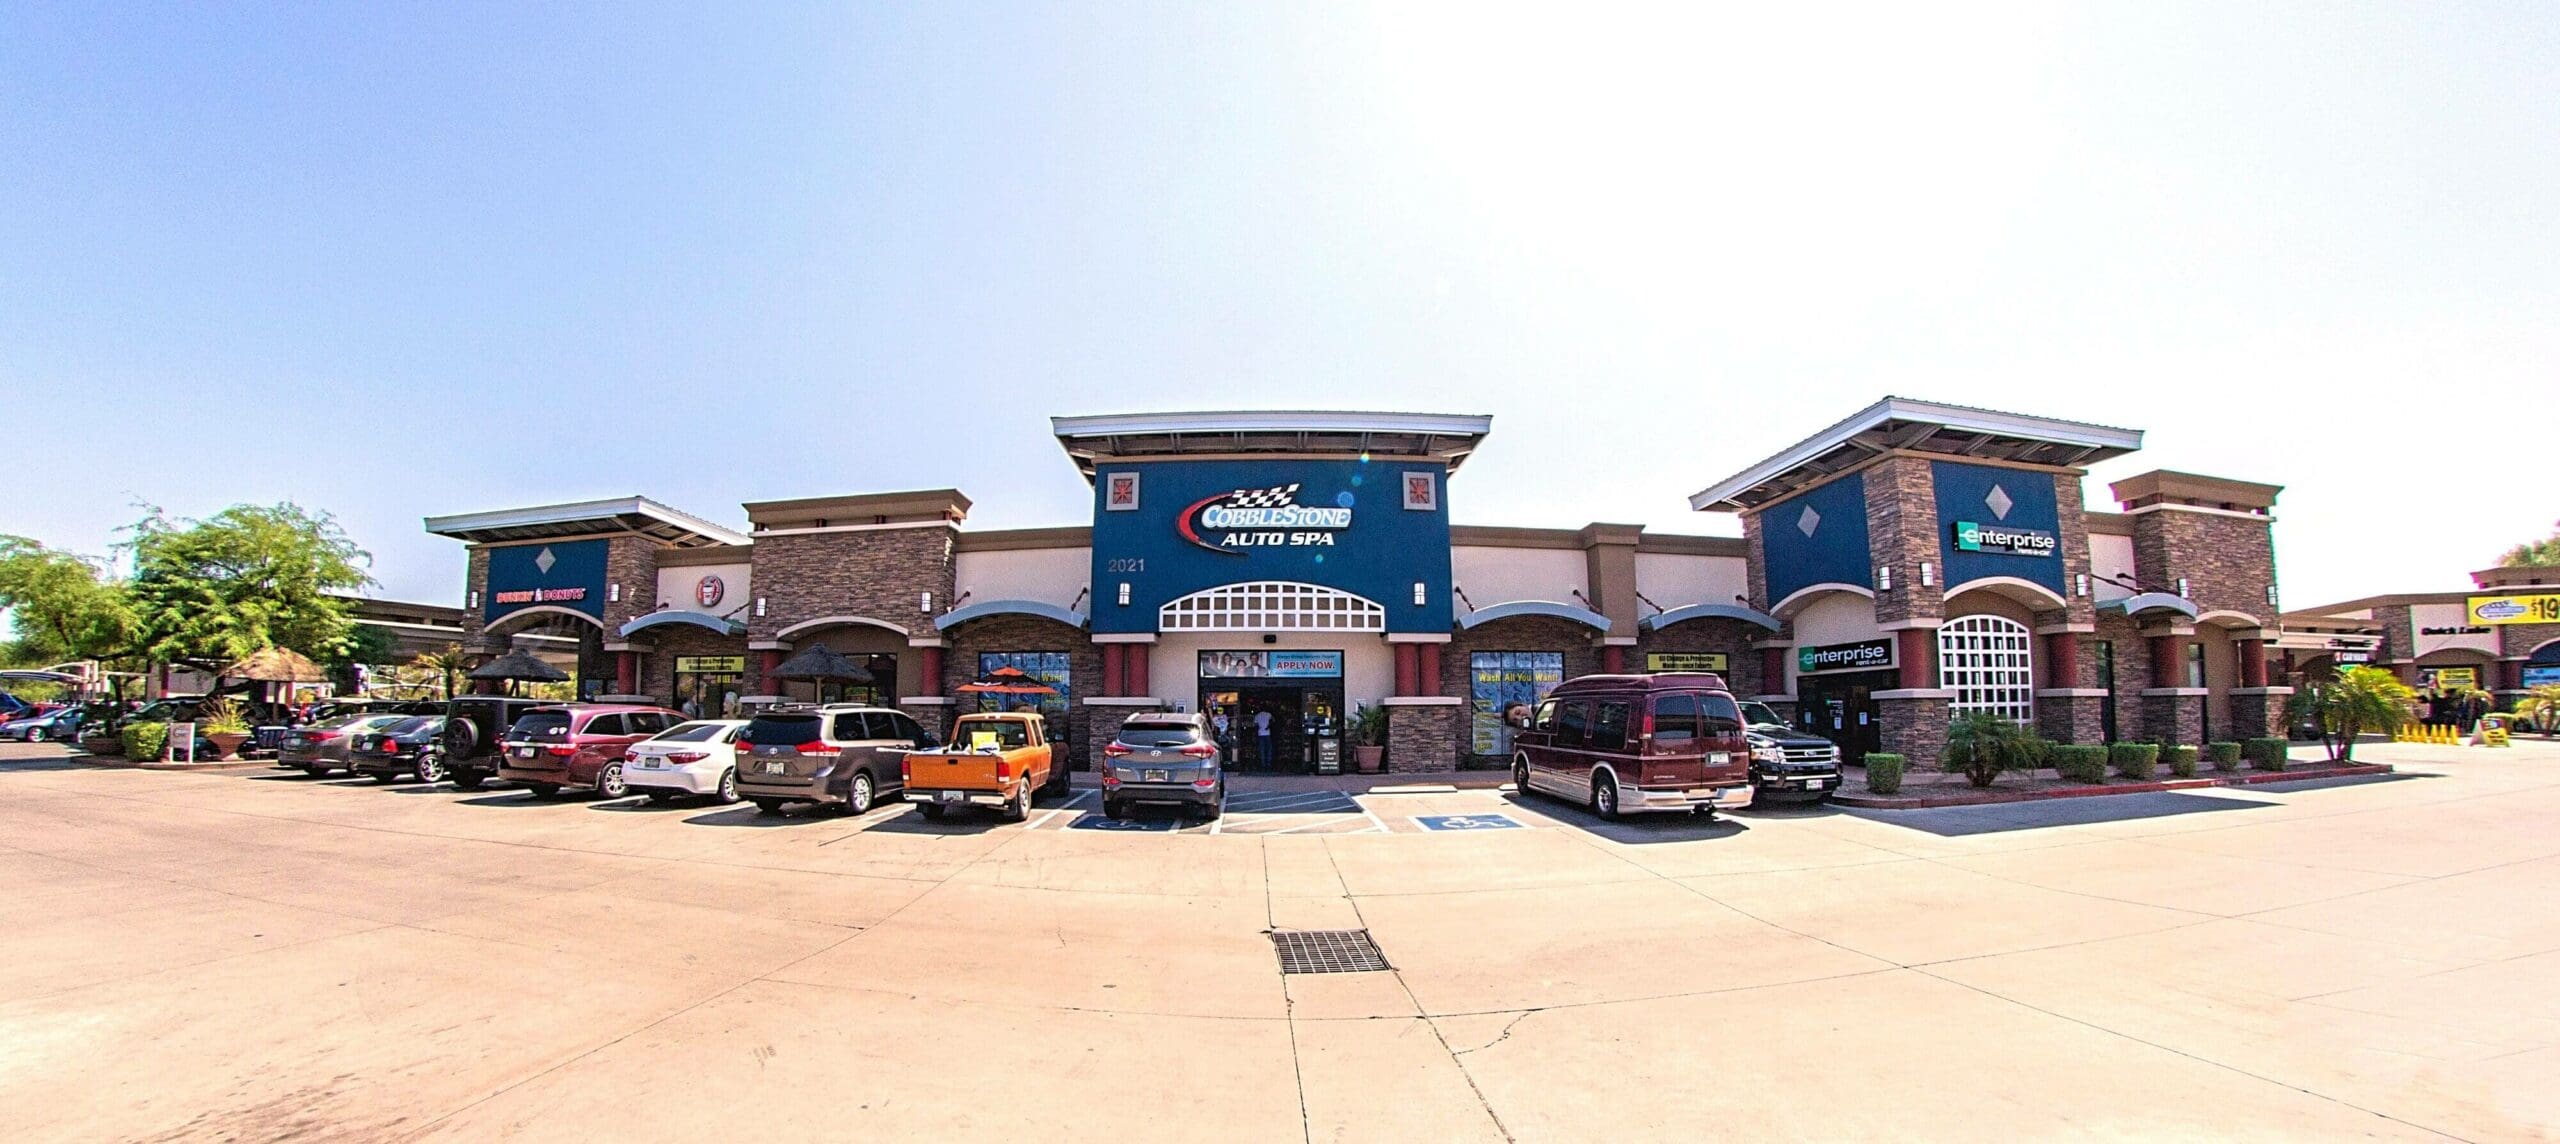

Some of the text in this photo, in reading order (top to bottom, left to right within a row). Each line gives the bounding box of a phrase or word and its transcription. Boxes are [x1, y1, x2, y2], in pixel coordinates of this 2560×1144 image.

[1221, 532, 1335, 546] AUTO SPA
[1963, 525, 2055, 550] enterprise
[1108, 558, 1144, 572] 2021
[543, 588, 584, 601] DONUTS
[1803, 644, 1885, 665] enterprise
[1276, 661, 1335, 670] APPLY NOW.
[1856, 658, 1888, 666] rent-a-car
[1042, 671, 1065, 682] Want!
[1479, 671, 1558, 682] Wash All You Want!
